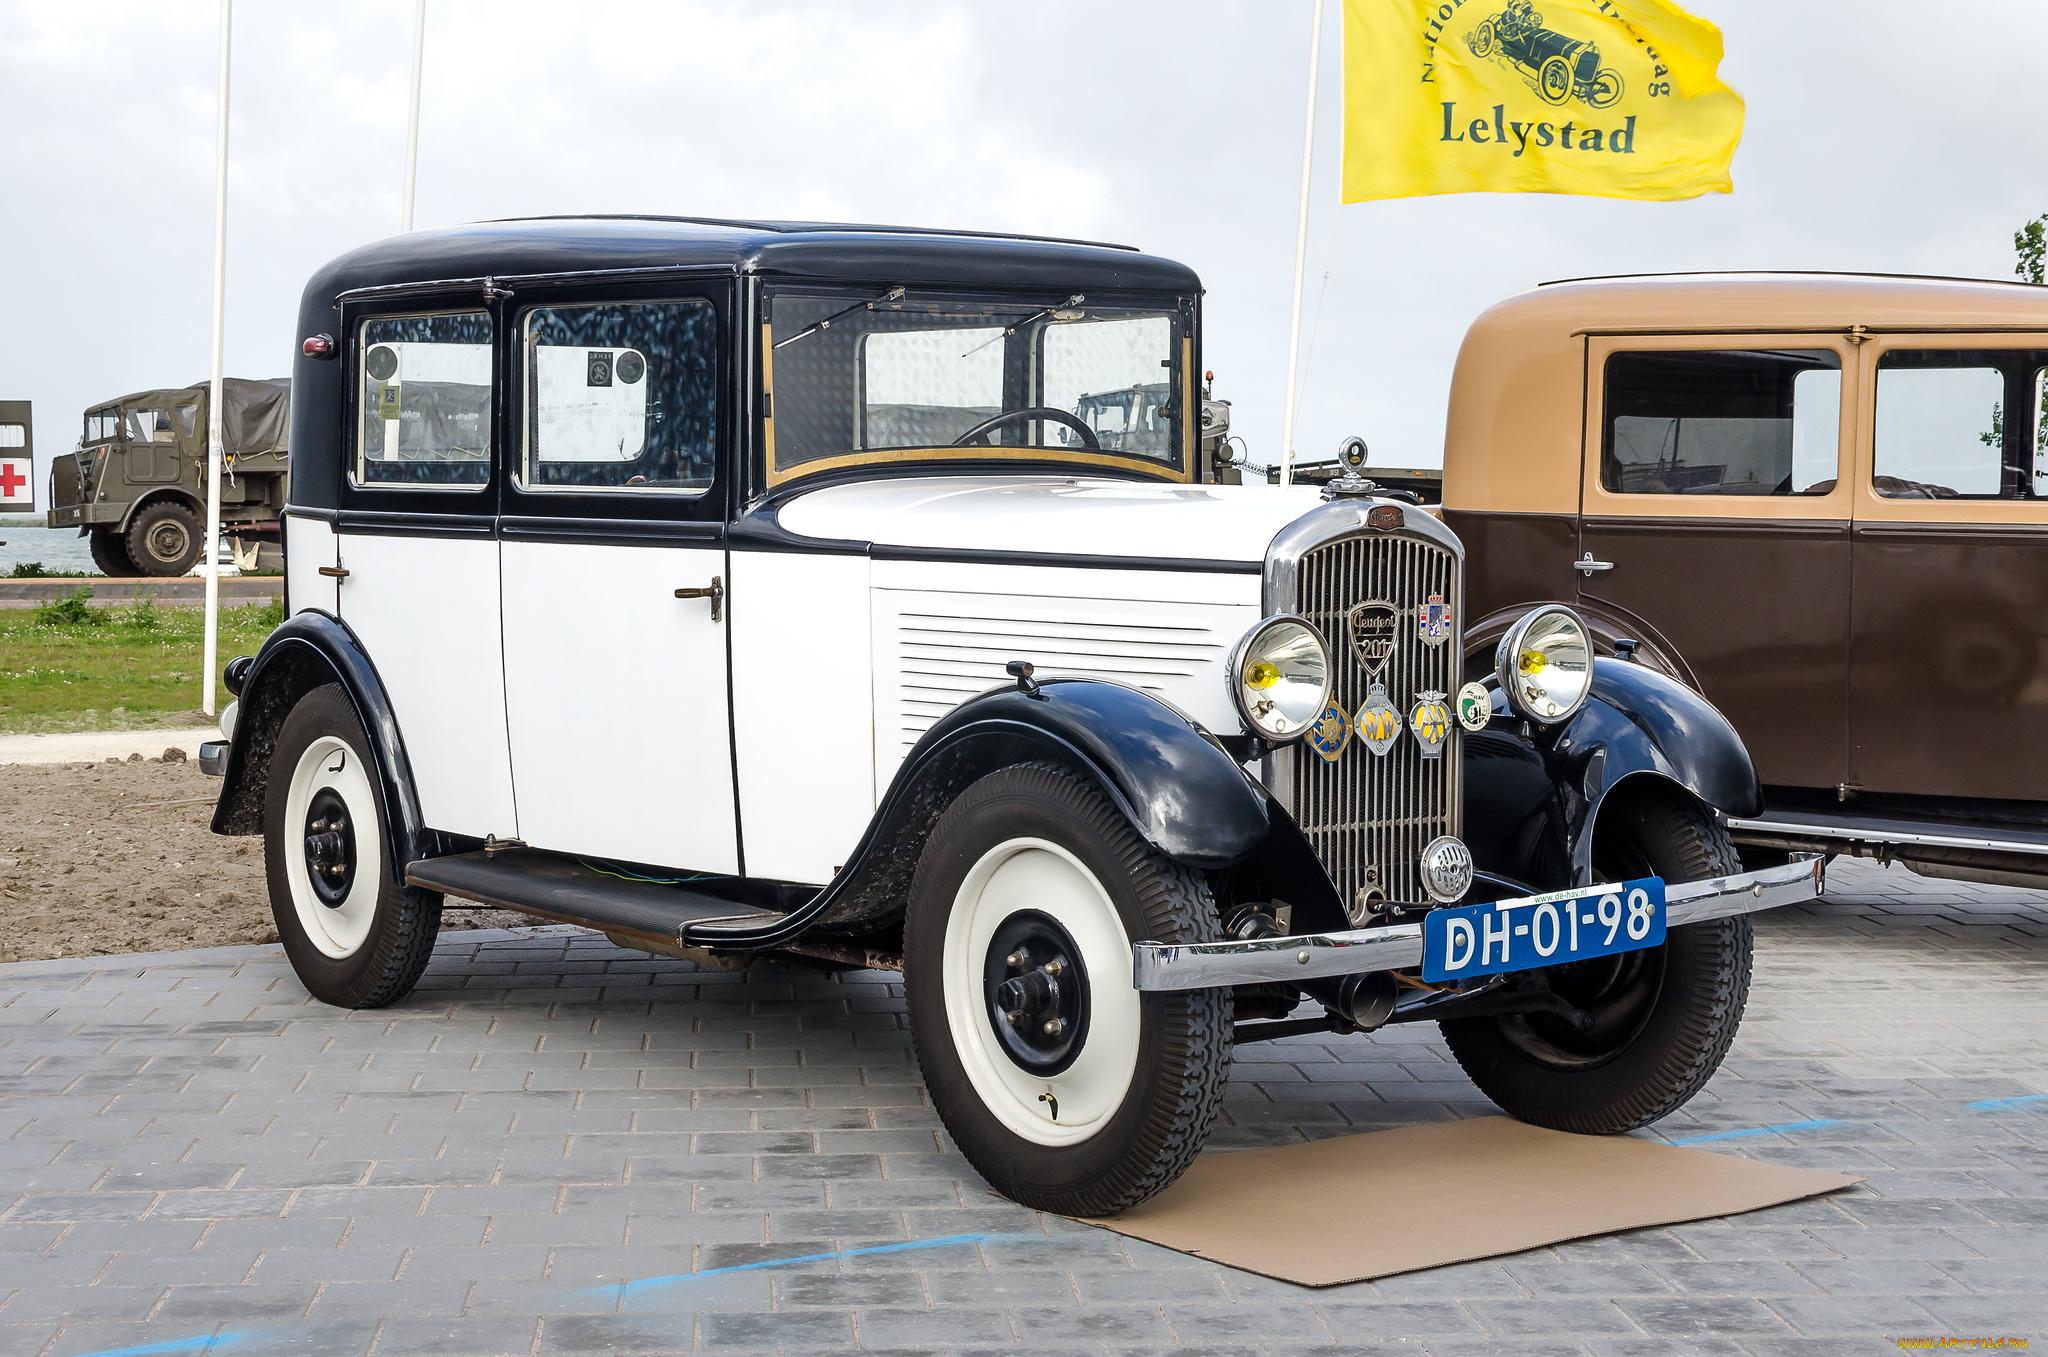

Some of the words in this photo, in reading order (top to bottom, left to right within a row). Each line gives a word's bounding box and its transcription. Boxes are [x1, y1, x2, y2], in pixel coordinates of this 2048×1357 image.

[1440, 101, 1638, 157] Lelystad
[1353, 610, 1396, 636] Peugeot
[1362, 638, 1387, 659] 201
[1534, 887, 1588, 904] www.de-hav.nl
[1444, 888, 1651, 972] DH-01-98
